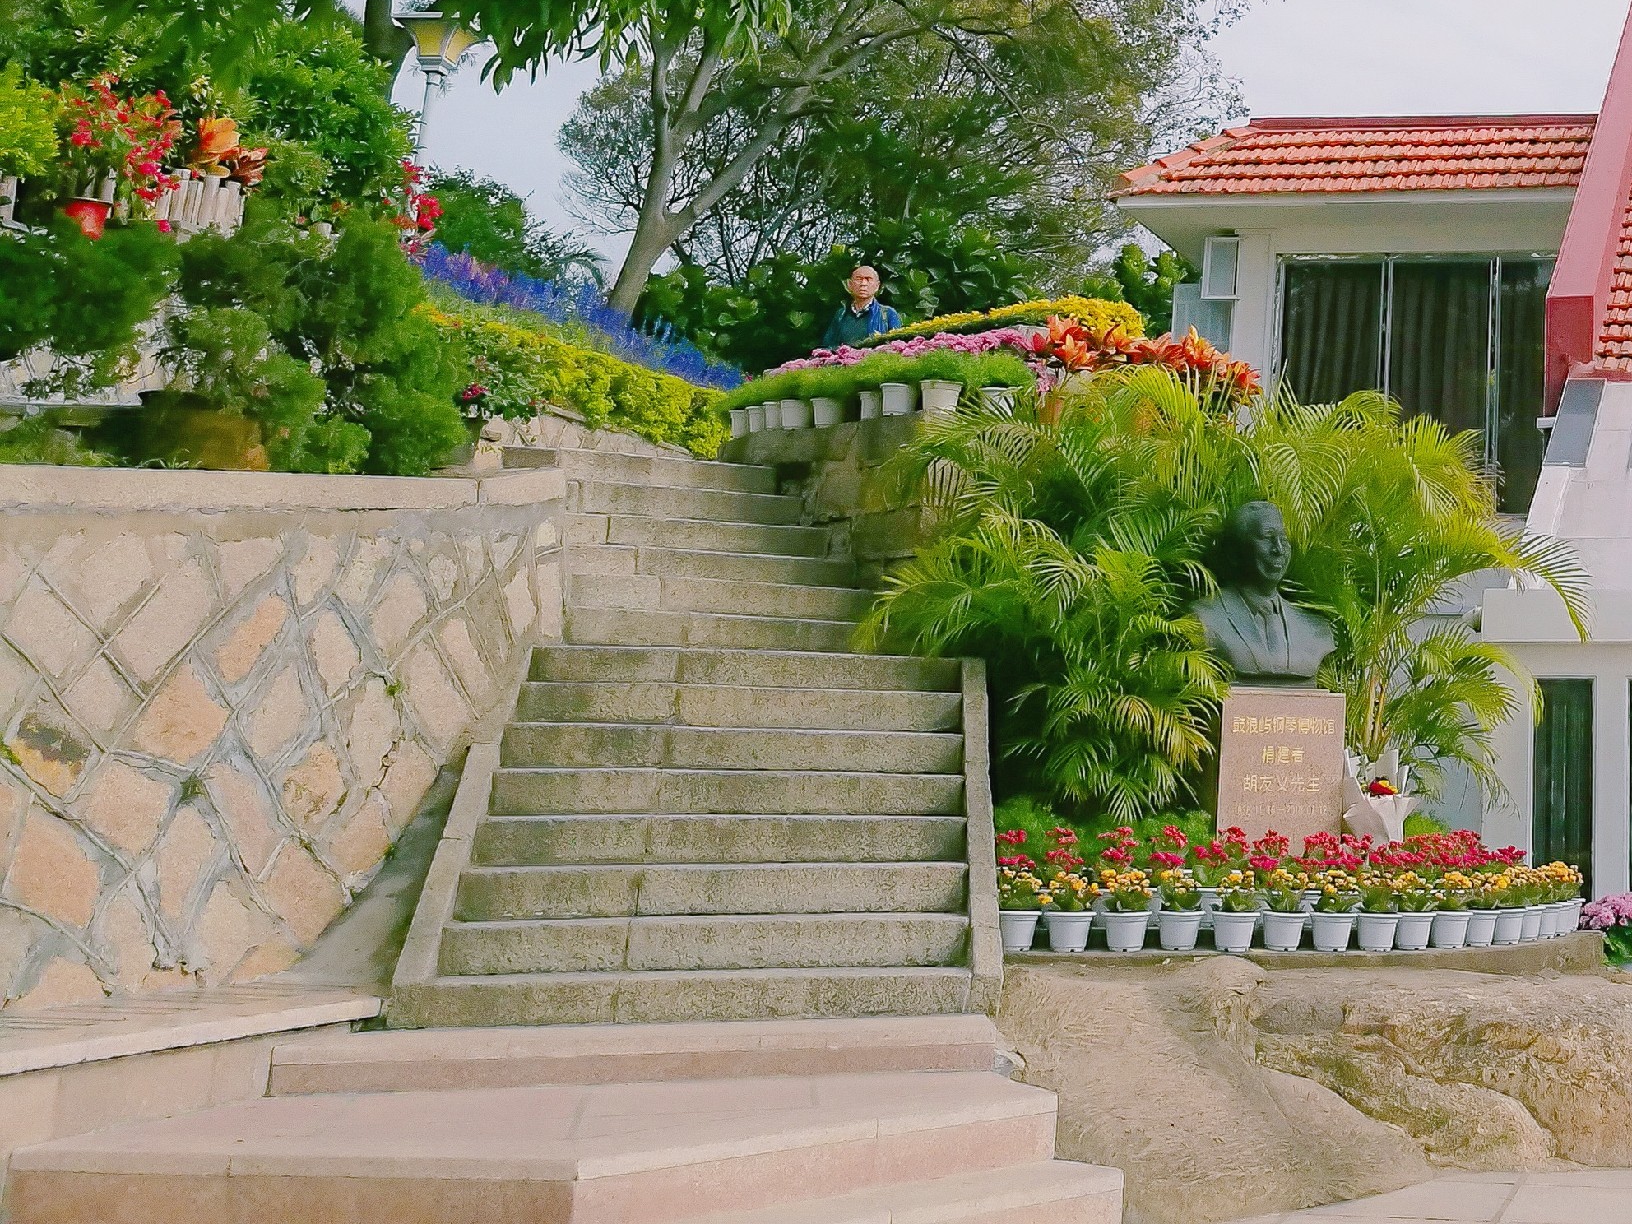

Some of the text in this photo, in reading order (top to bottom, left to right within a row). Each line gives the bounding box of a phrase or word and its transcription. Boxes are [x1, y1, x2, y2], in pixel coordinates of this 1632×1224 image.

[1232, 716, 1335, 735] 鼓浪屿钢琴博物馆
[1243, 774, 1321, 793] 胡友义先生
